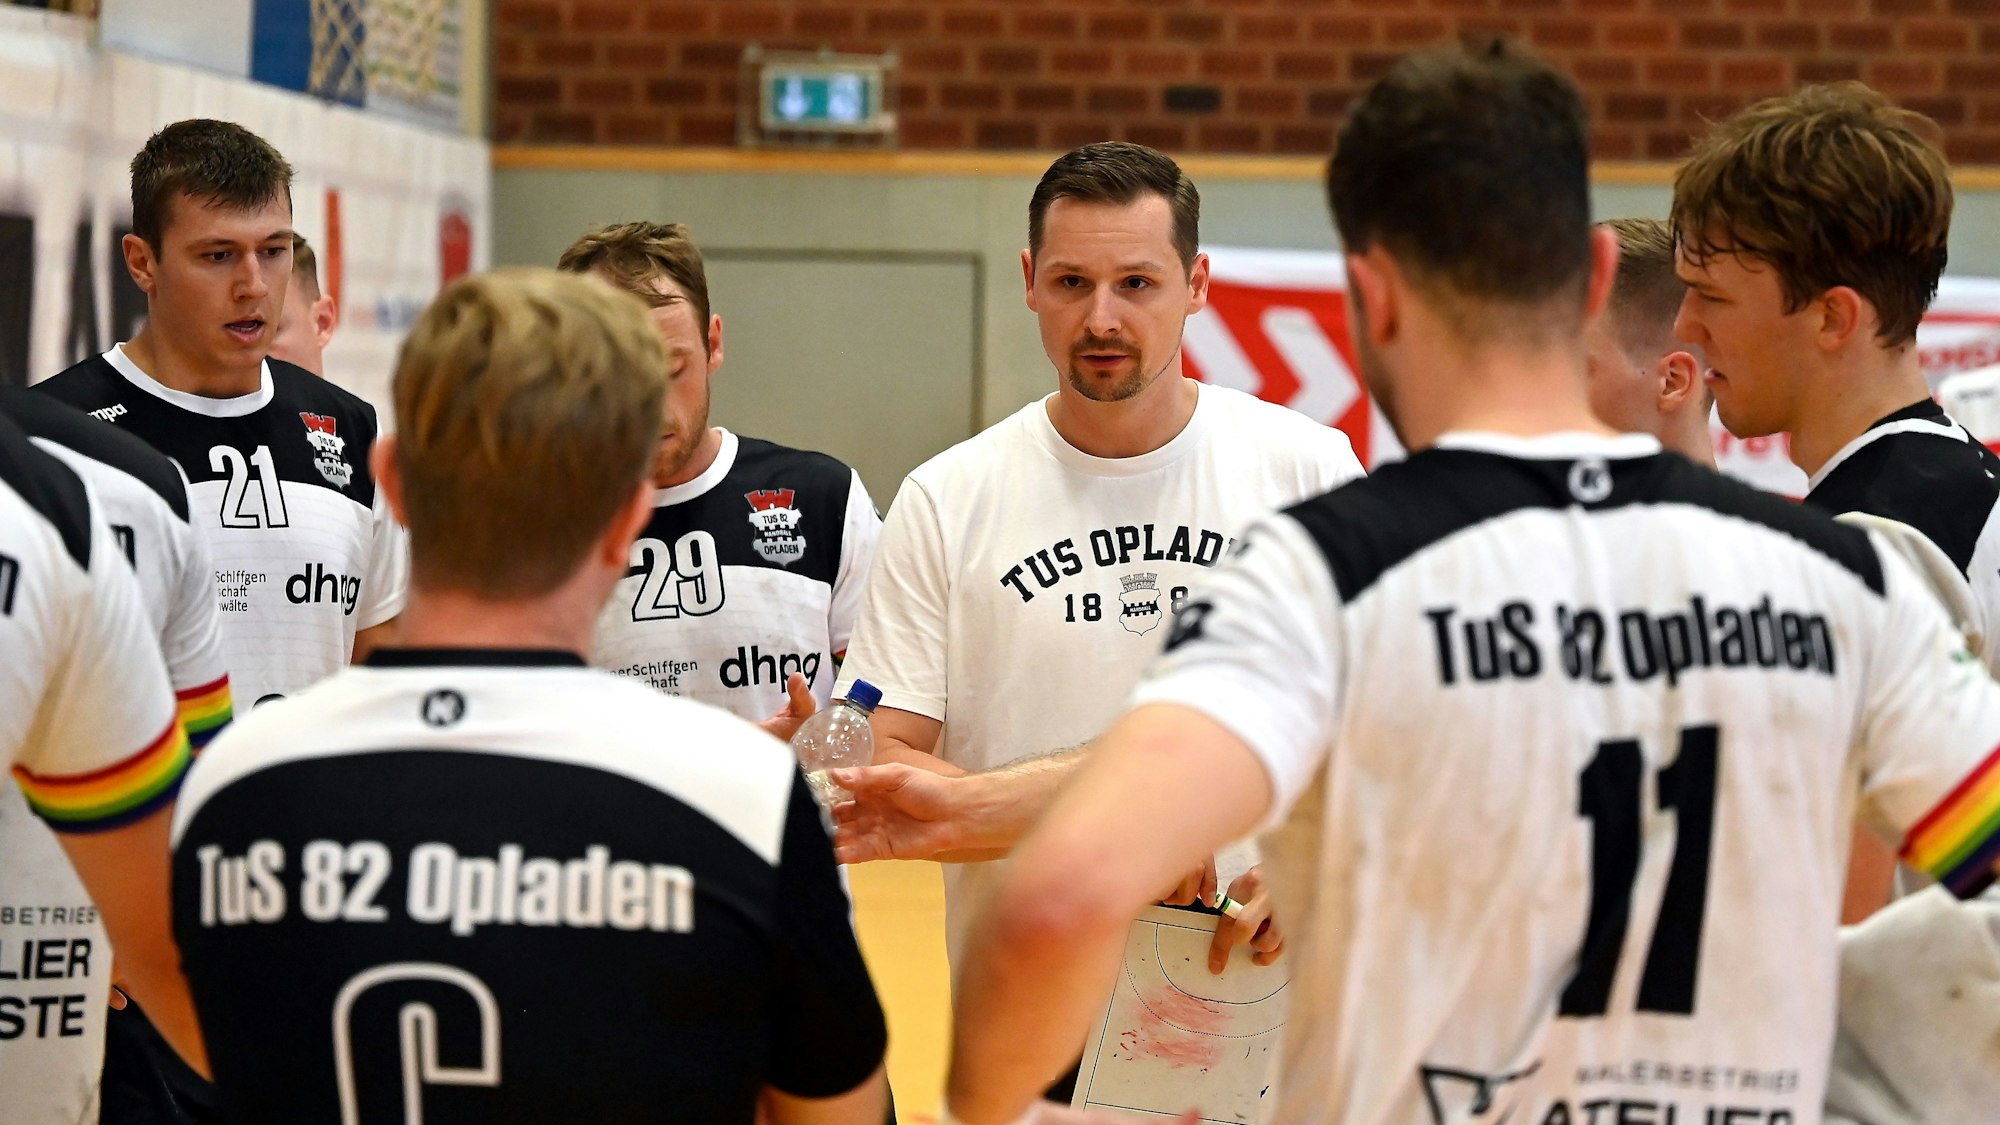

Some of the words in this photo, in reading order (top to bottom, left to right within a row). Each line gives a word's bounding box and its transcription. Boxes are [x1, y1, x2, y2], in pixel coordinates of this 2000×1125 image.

[208, 444, 289, 529] 21
[762, 514, 778, 524] TUS
[779, 513, 788, 523] 82
[628, 530, 725, 622] 29
[764, 545, 799, 555] OPLADEN
[1000, 538, 1083, 603] TUS
[1089, 523, 1238, 568] OPLAD
[1065, 592, 1101, 622] 18
[1425, 601, 1542, 686] TuS
[1619, 593, 1836, 687] Opladen
[719, 645, 821, 693] dhpg
[197, 839, 287, 928] TuS
[300, 839, 392, 923] 82
[406, 841, 696, 936] Opladen
[1556, 722, 1722, 1017] 11
